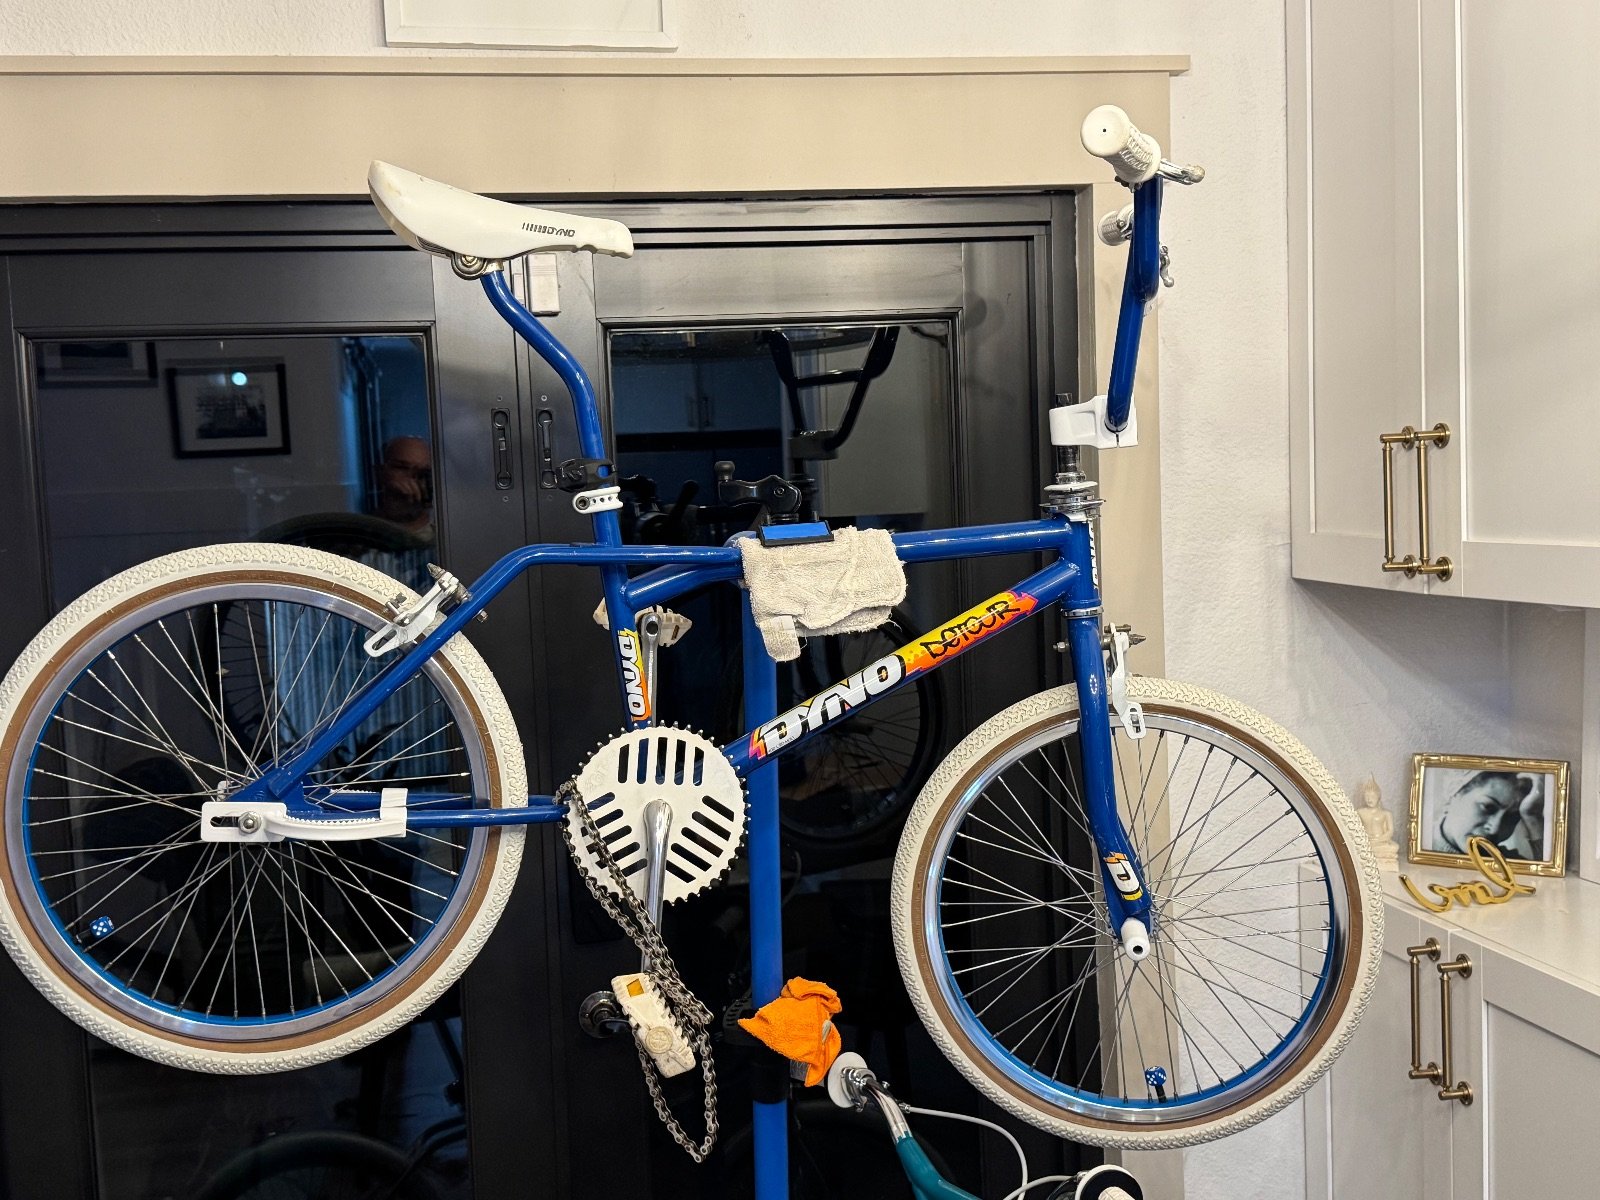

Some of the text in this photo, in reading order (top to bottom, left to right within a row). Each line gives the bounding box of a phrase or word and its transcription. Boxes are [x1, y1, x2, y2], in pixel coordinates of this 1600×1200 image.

[547, 226, 576, 238] DYNO
[920, 600, 1020, 658] DETOUR
[617, 634, 647, 717] DYNO
[759, 653, 906, 756] DYNO
